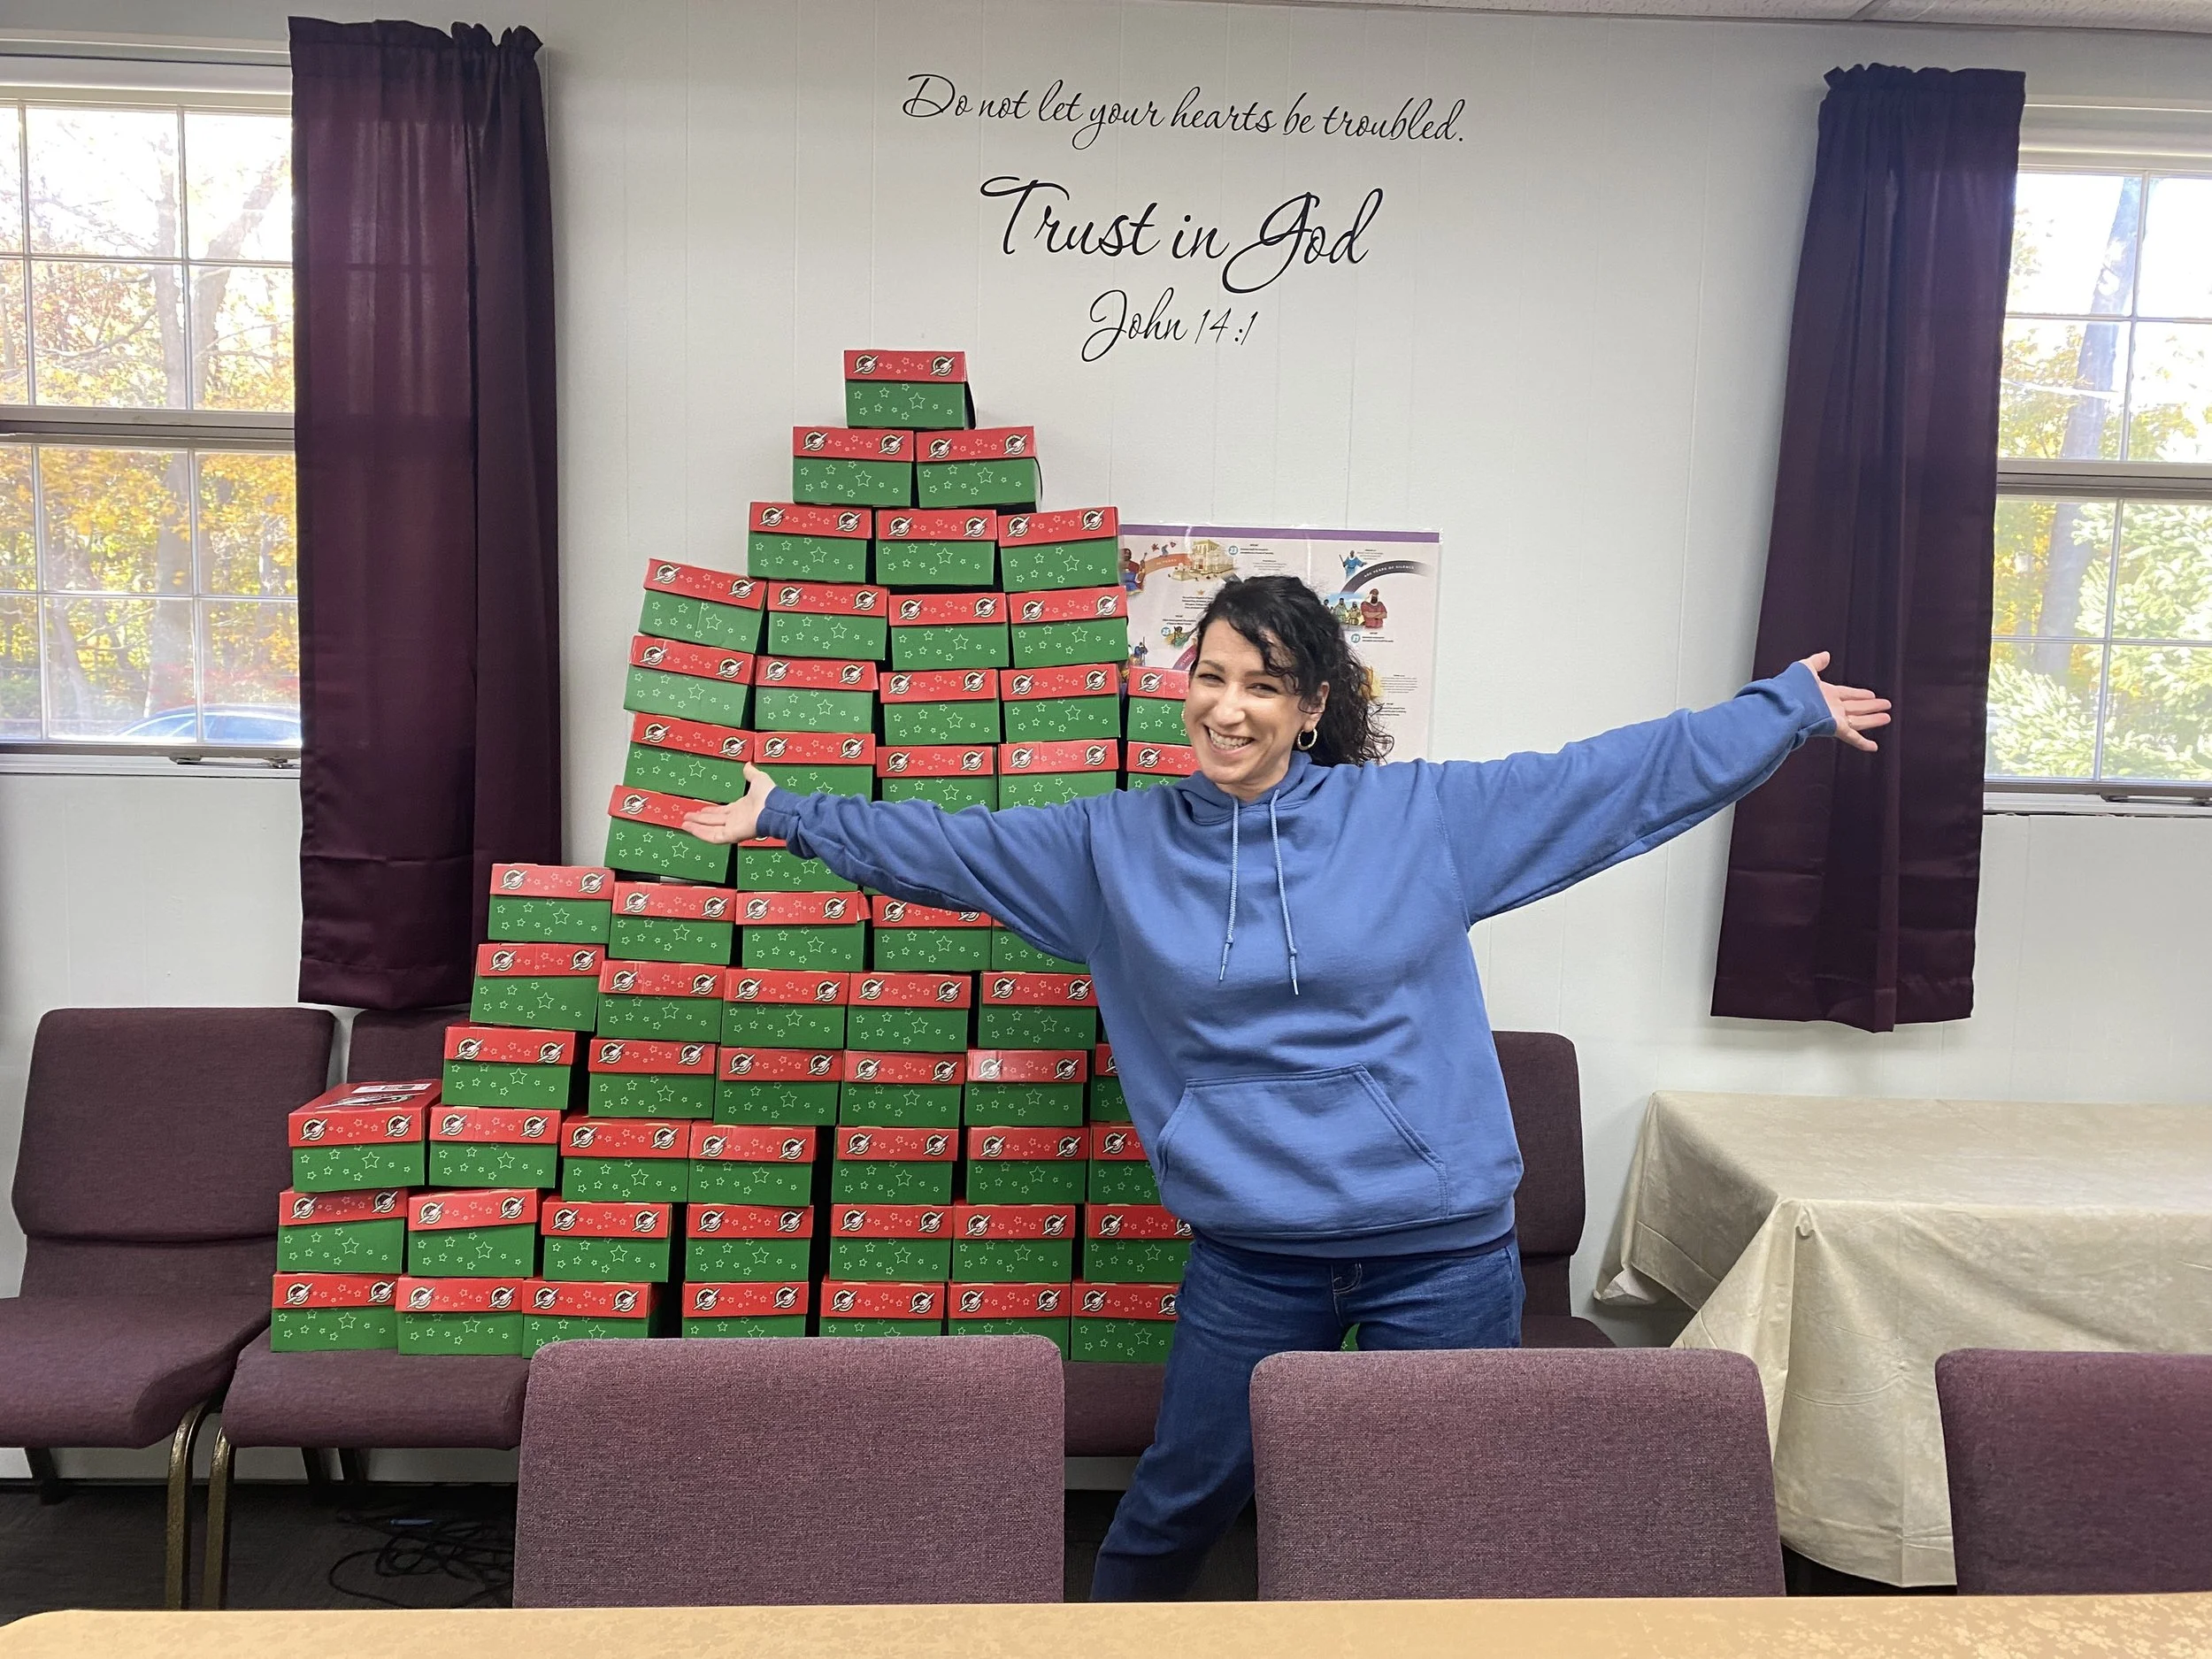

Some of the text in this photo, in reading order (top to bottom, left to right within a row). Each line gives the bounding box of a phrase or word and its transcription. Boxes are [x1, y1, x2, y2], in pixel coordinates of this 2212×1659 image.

[902, 73, 1466, 150] Do not let your hearts be troubled.
[979, 176, 1384, 294] Trust in God
[1081, 288, 1259, 363] John 14:1
